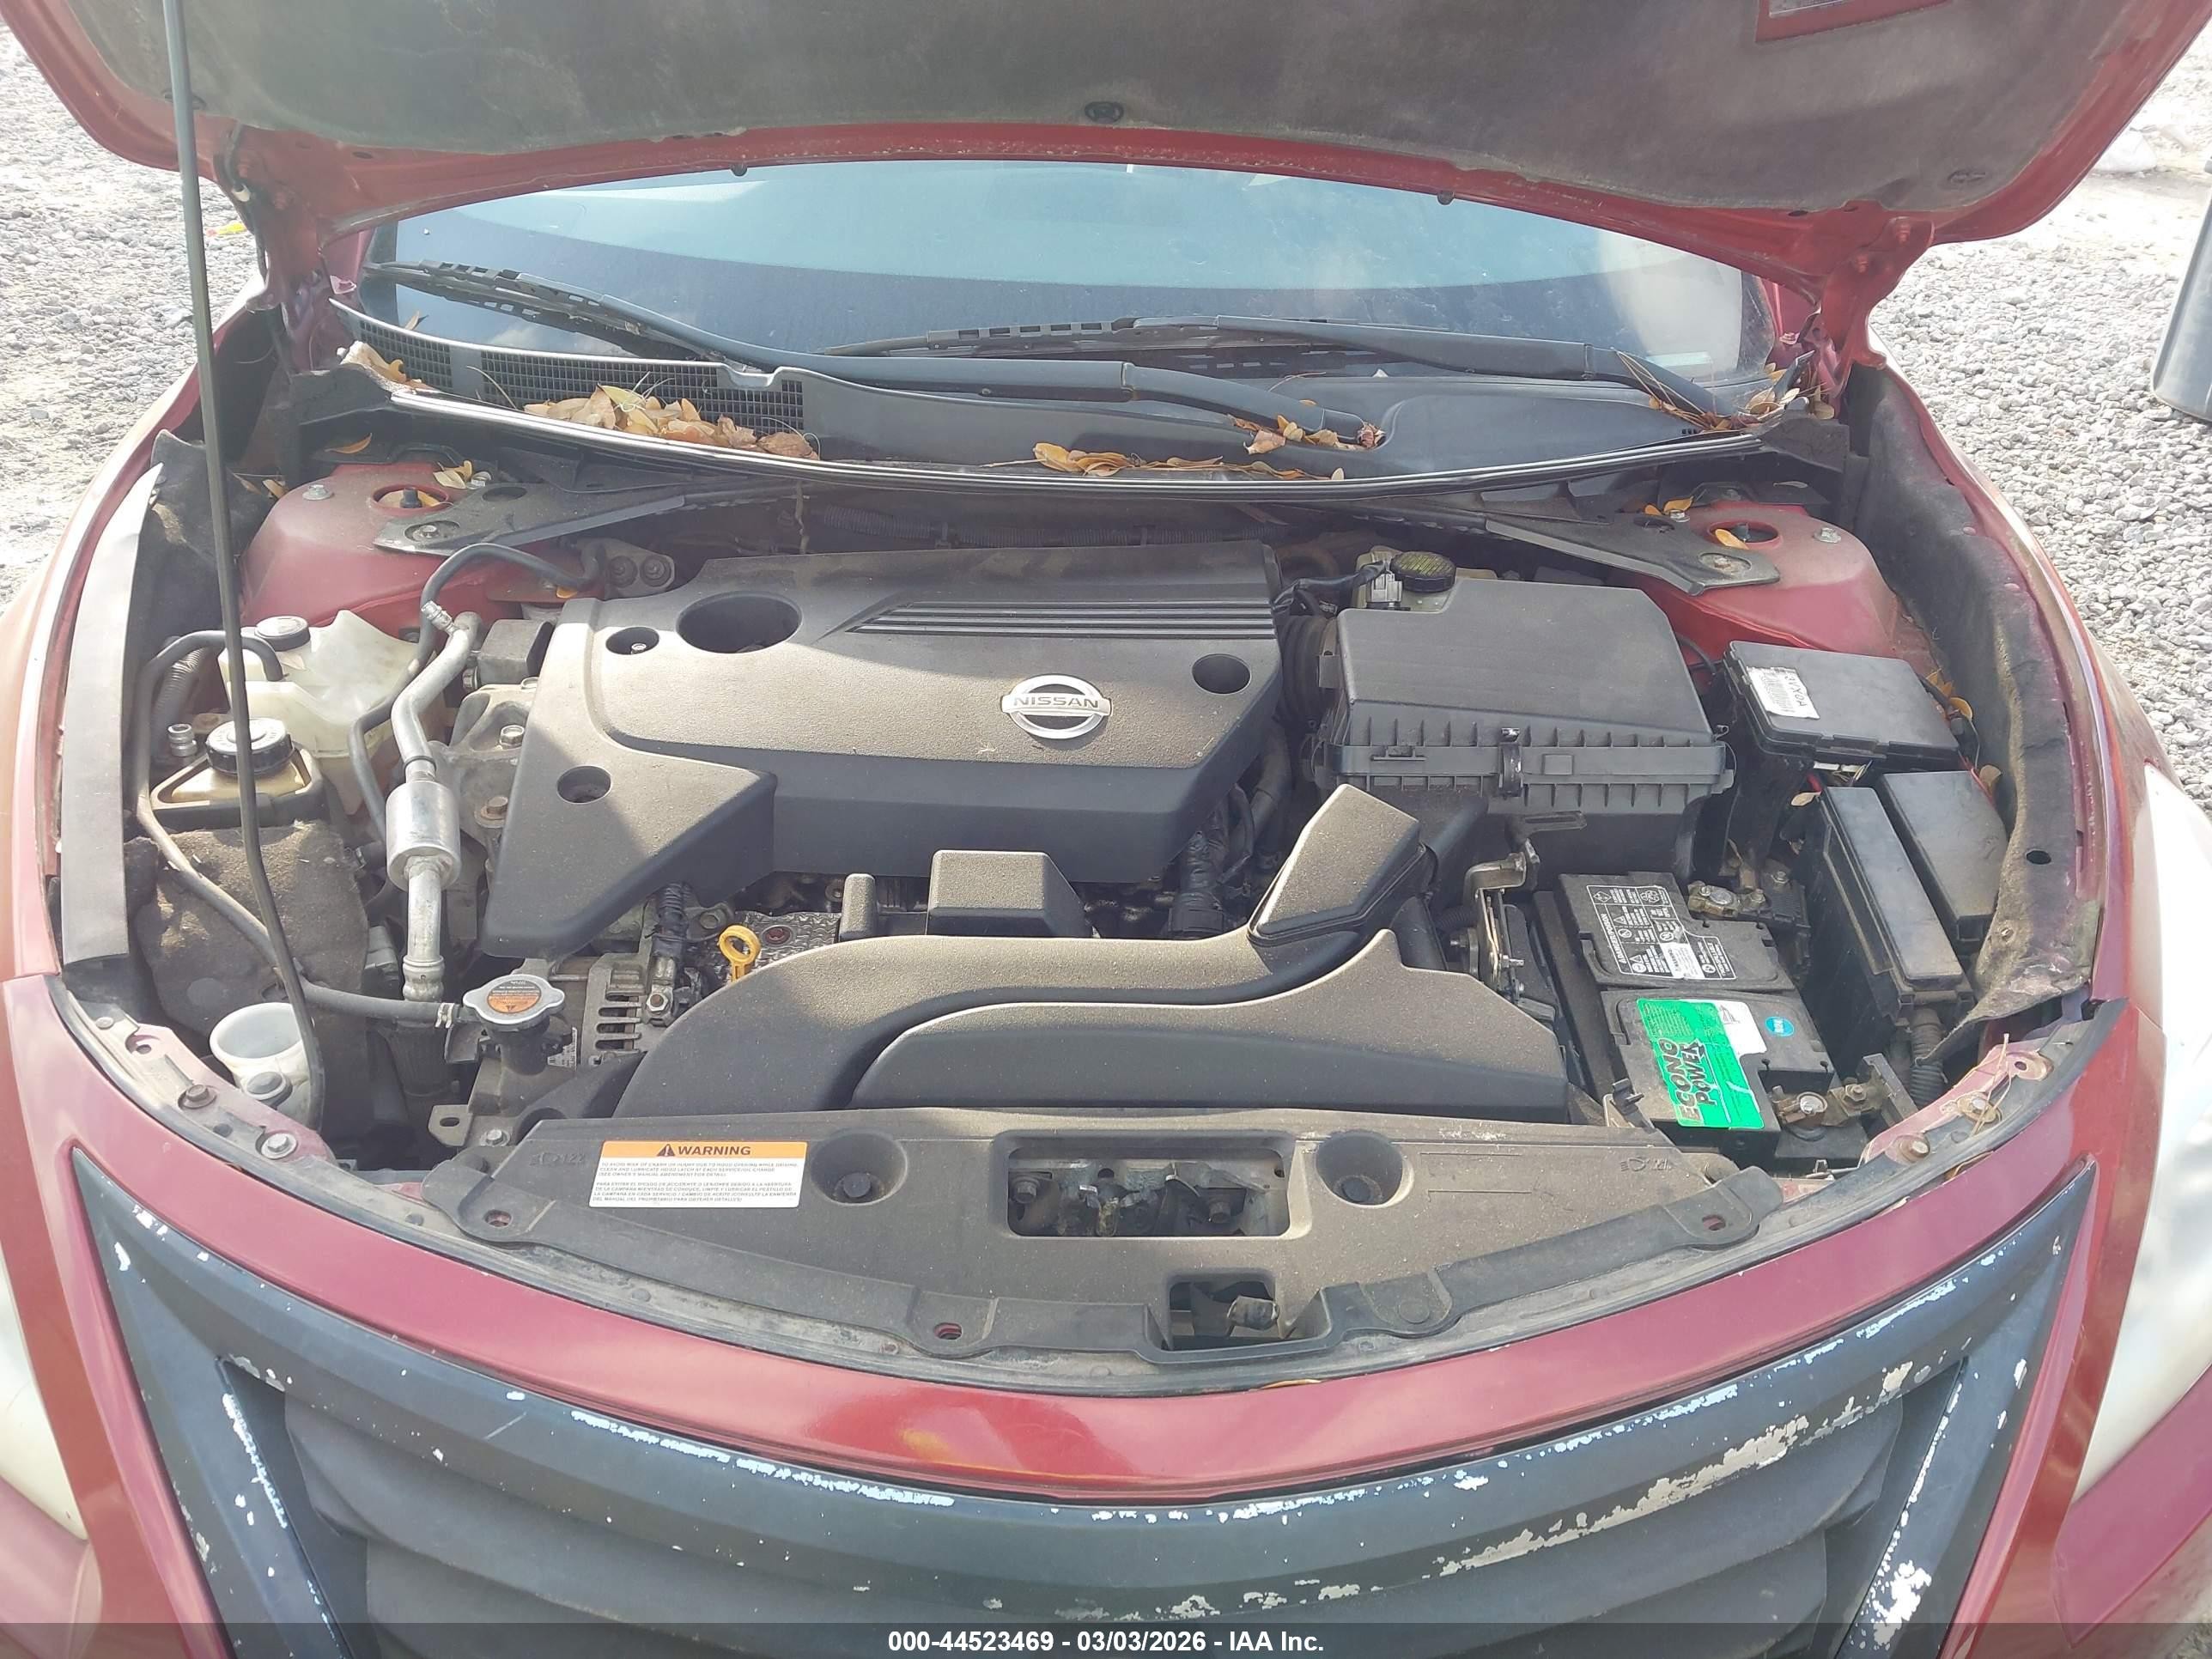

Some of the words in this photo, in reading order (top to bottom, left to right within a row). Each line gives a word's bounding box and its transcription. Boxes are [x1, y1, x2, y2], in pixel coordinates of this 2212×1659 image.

[1013, 696, 1098, 708] NISSAN
[1658, 1037, 1702, 1121] ECONO
[1680, 1038, 1717, 1106] POWER
[678, 1146, 751, 1156] WARNING
